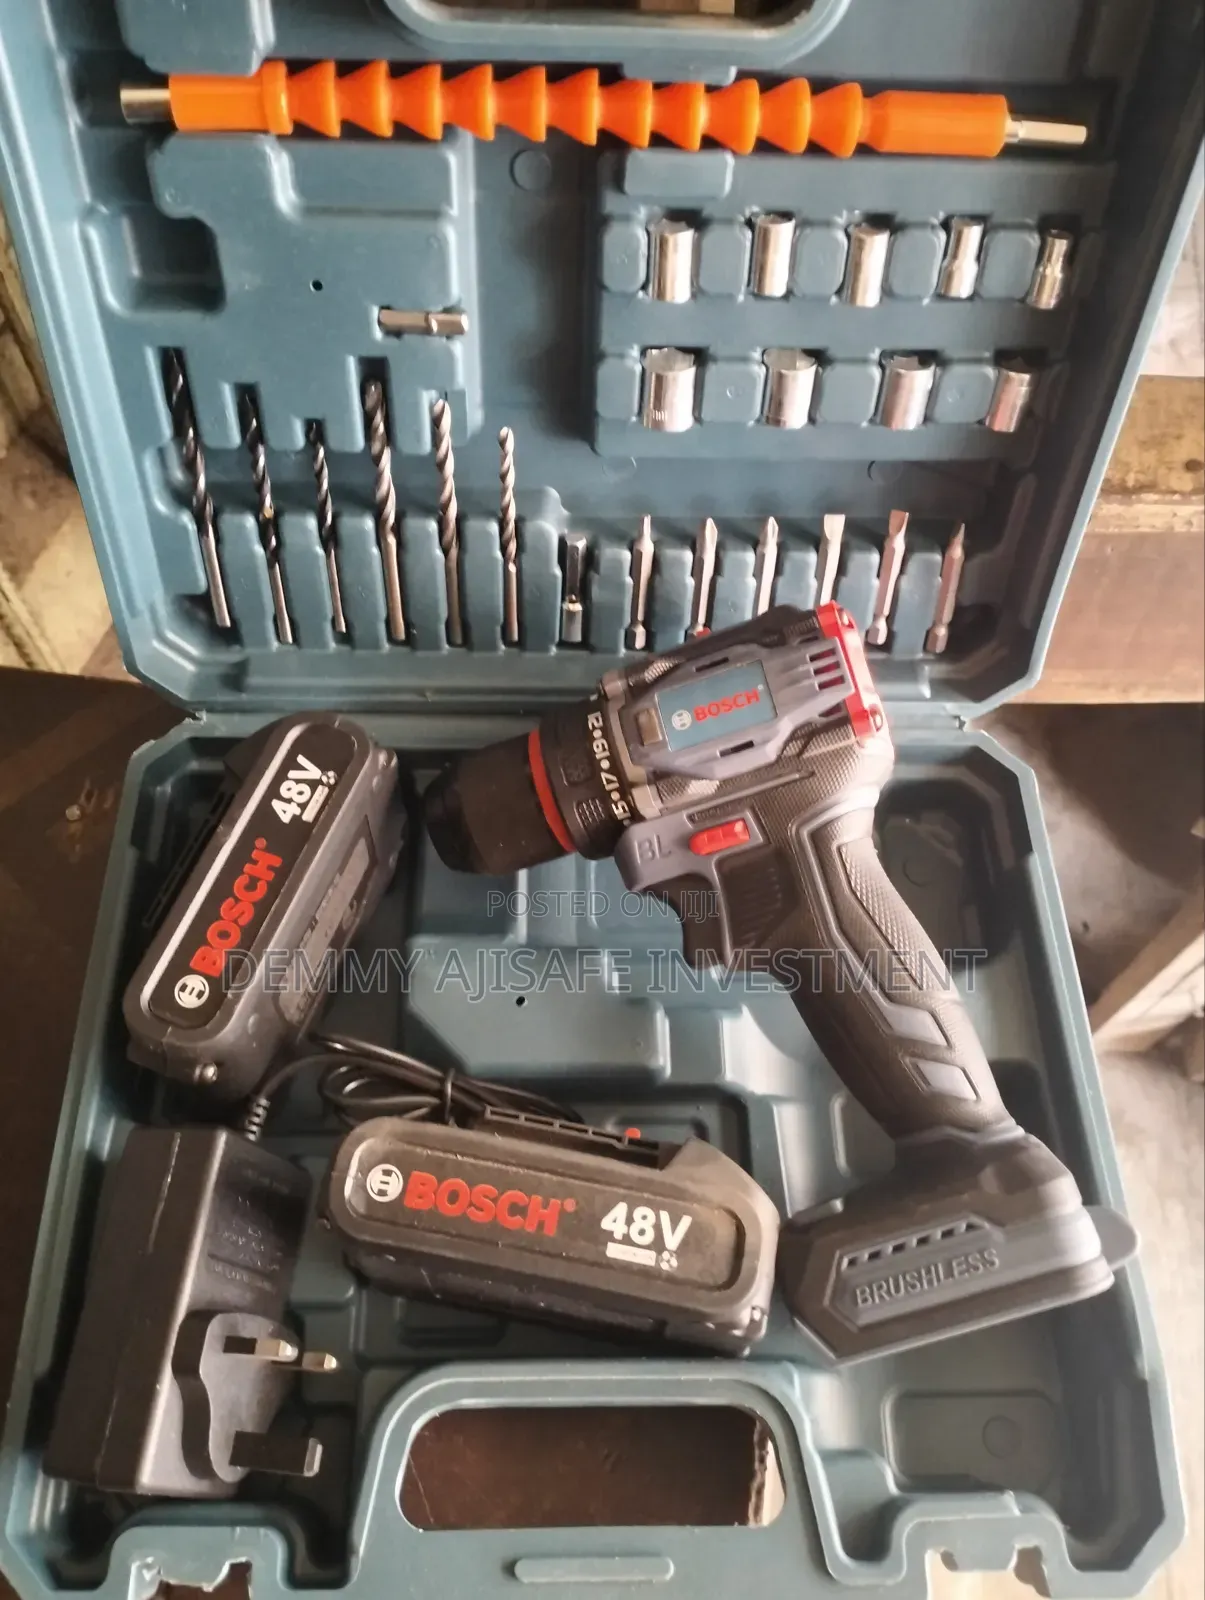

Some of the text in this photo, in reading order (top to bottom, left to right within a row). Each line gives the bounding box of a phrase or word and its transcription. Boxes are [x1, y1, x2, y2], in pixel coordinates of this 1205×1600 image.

[694, 688, 760, 722] BOSCH
[271, 754, 322, 824] 48V
[637, 834, 672, 862] BL
[189, 845, 283, 978] BOSCH
[404, 1171, 692, 1251] BOSCH 48V
[855, 1248, 1000, 1307] BRUSHLESS
